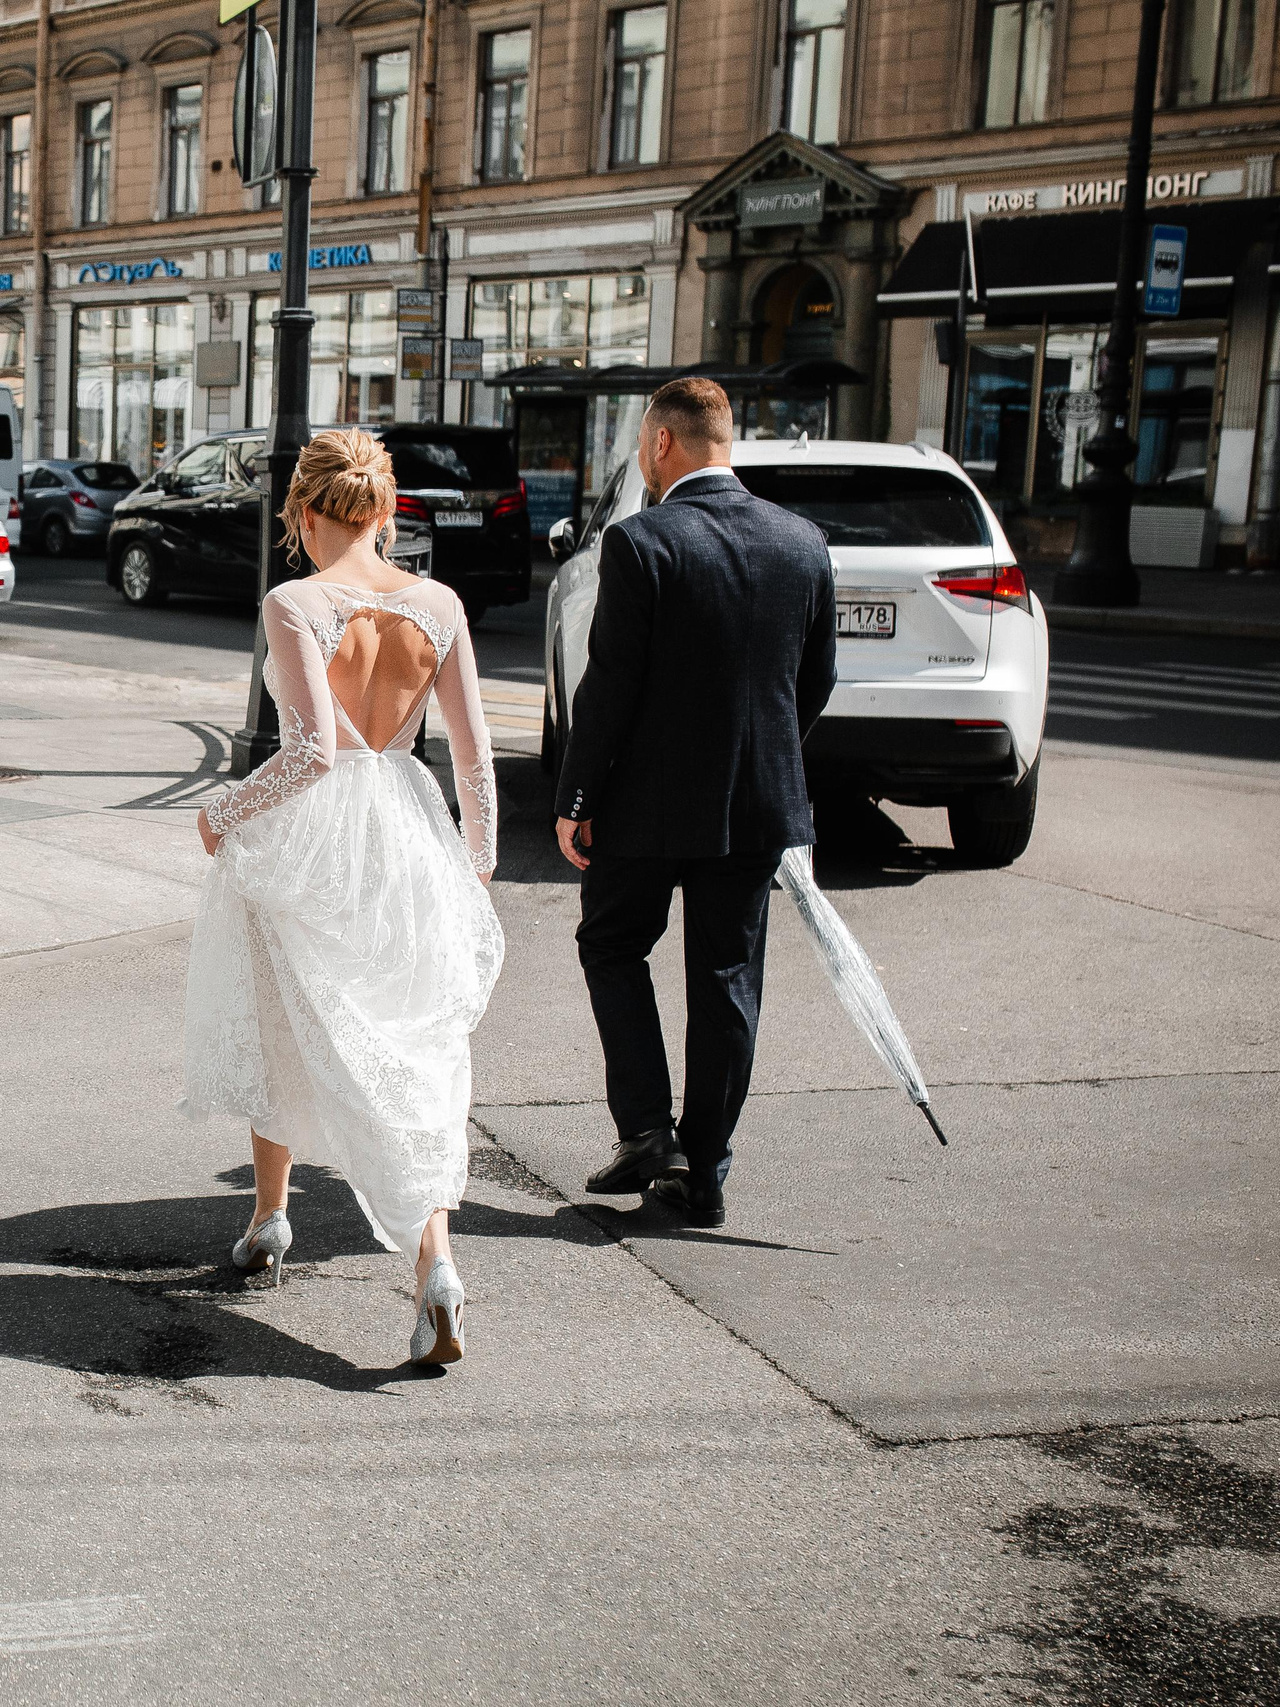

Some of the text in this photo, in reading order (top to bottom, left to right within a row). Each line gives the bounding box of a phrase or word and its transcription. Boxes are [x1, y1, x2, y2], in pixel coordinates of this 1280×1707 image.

[984, 190, 1037, 213] КАФЕ
[268, 243, 371, 272] КЕТИКА
[852, 606, 887, 625] 178
